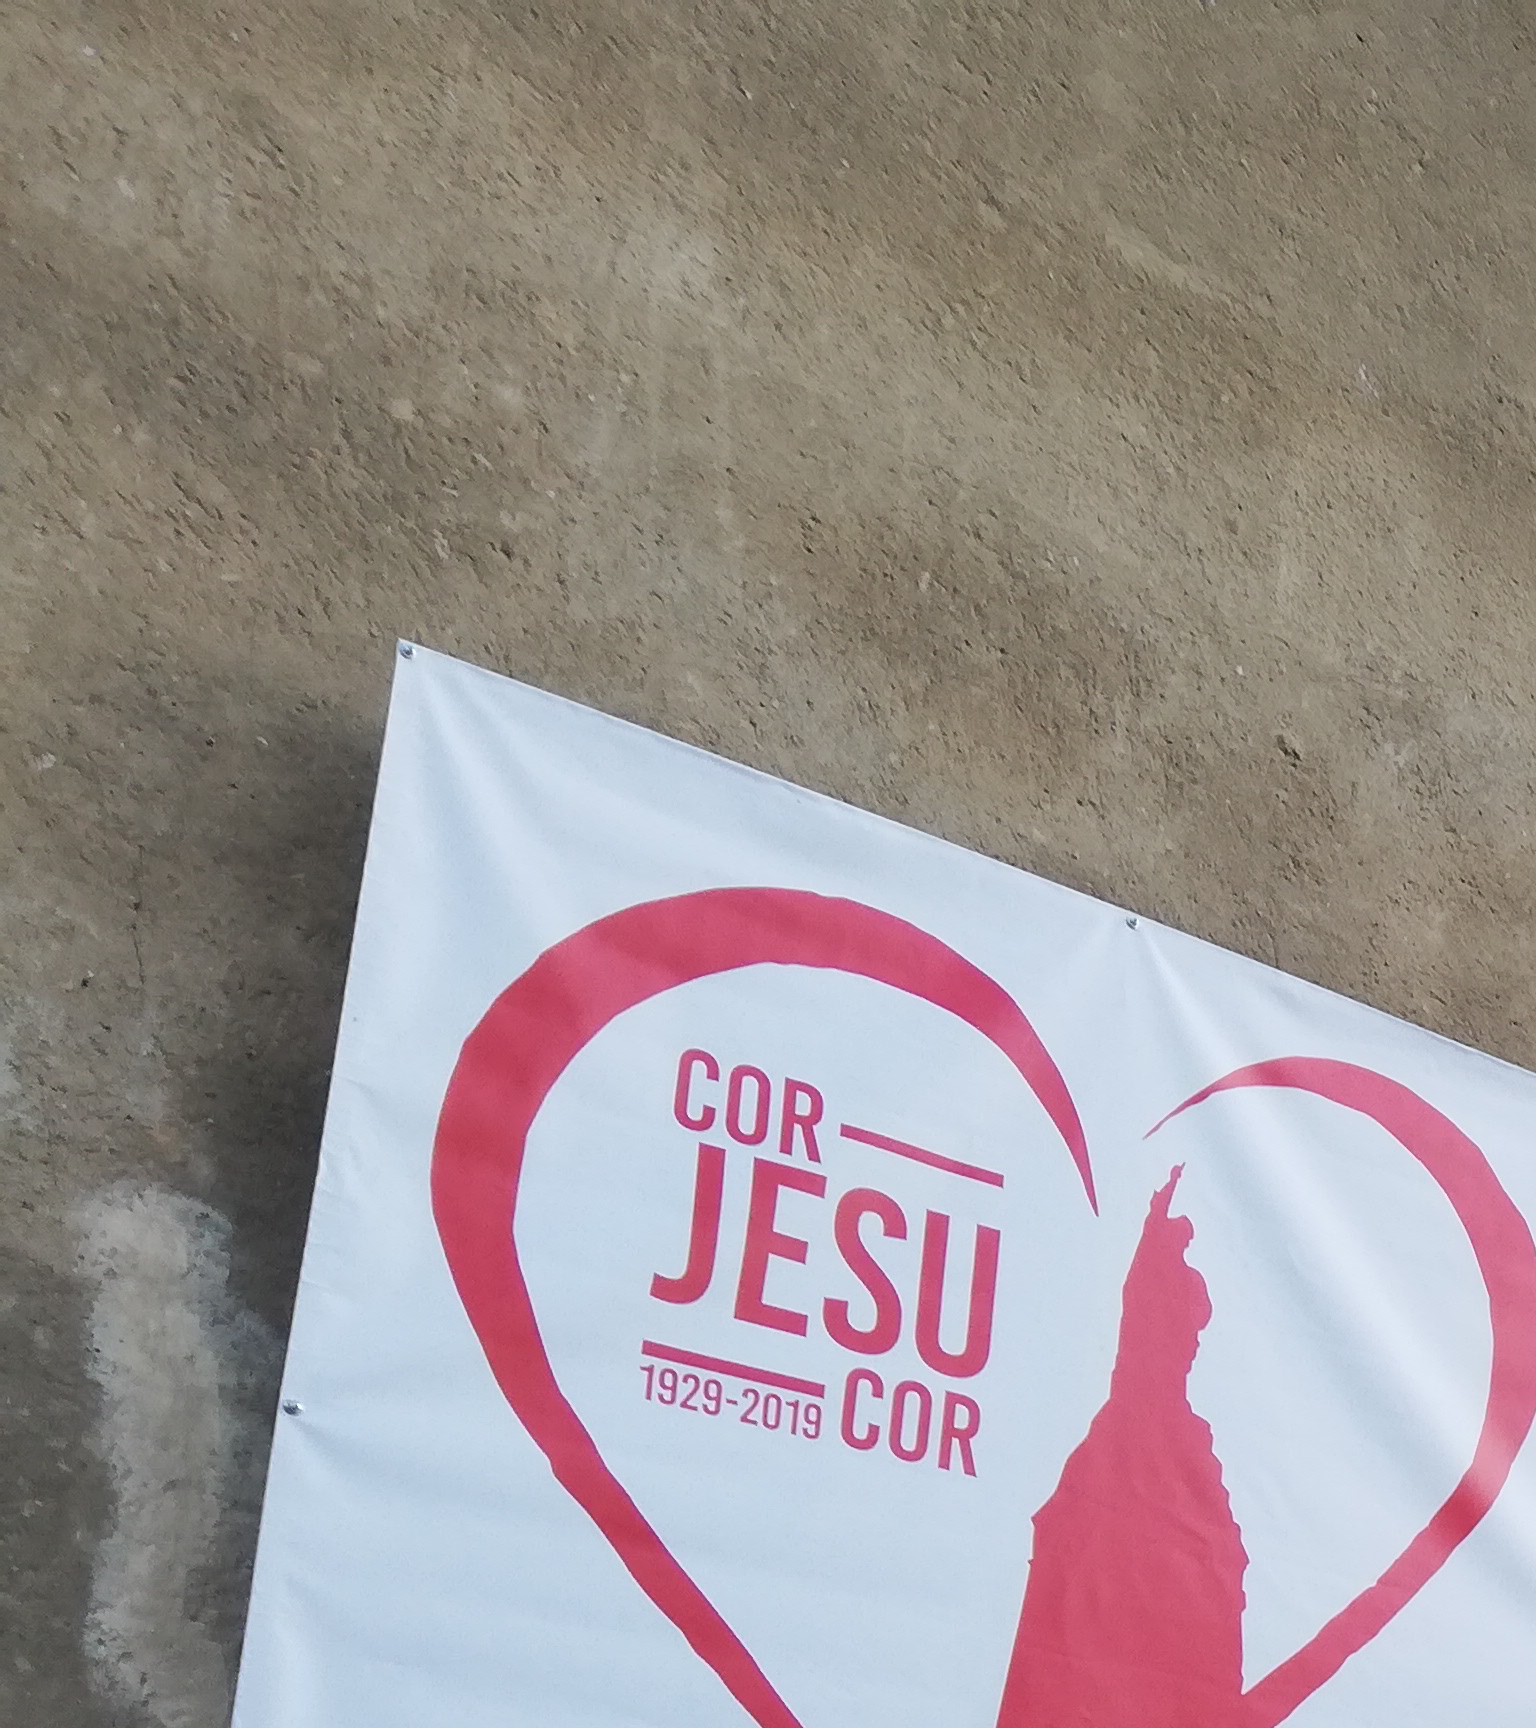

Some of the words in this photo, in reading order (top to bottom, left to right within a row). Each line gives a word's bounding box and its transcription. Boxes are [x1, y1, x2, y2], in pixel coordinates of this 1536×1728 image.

[673, 1048, 824, 1164] COR
[650, 1142, 1001, 1379] JESU
[641, 1364, 823, 1440] 1929-2019
[840, 1367, 981, 1478] COR
